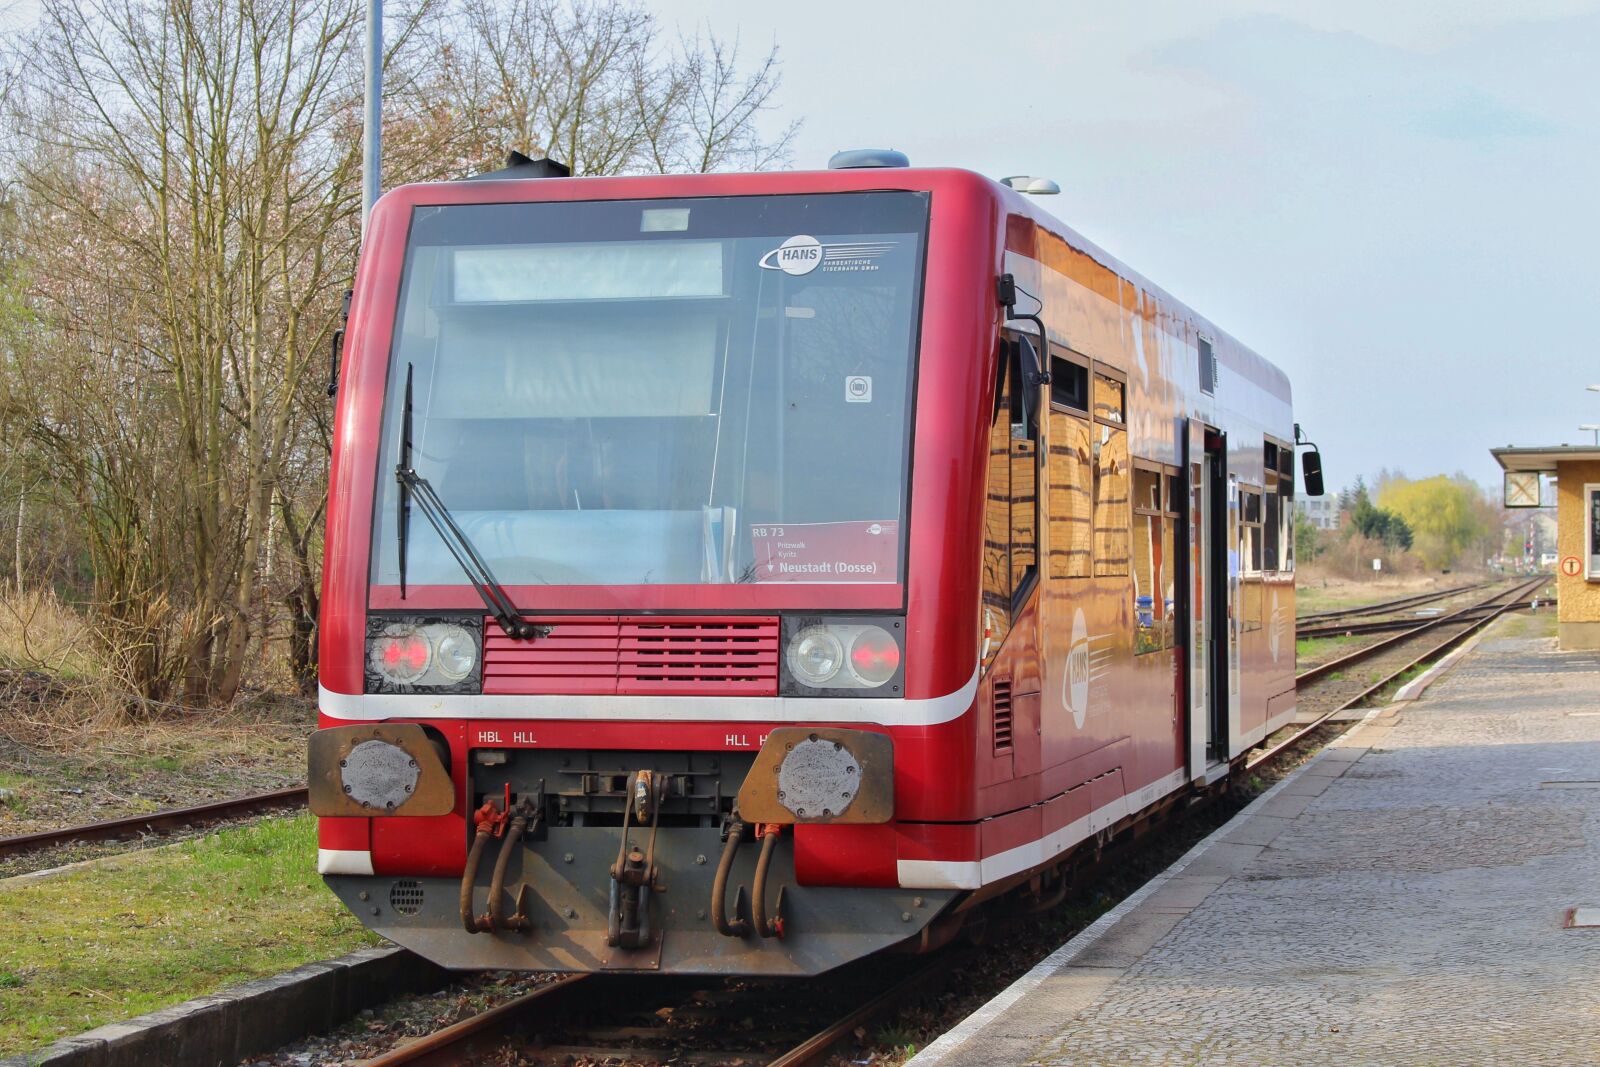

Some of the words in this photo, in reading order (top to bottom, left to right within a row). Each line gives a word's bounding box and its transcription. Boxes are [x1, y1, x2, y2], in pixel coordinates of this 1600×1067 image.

[782, 249, 818, 260] HANS
[752, 528, 768, 537] RB
[770, 527, 785, 537] 73
[779, 562, 832, 573] Neustadt
[834, 561, 877, 574] (Dosse)
[478, 731, 503, 743] HBL
[513, 731, 537, 743] HLL
[725, 734, 750, 746] HLL
